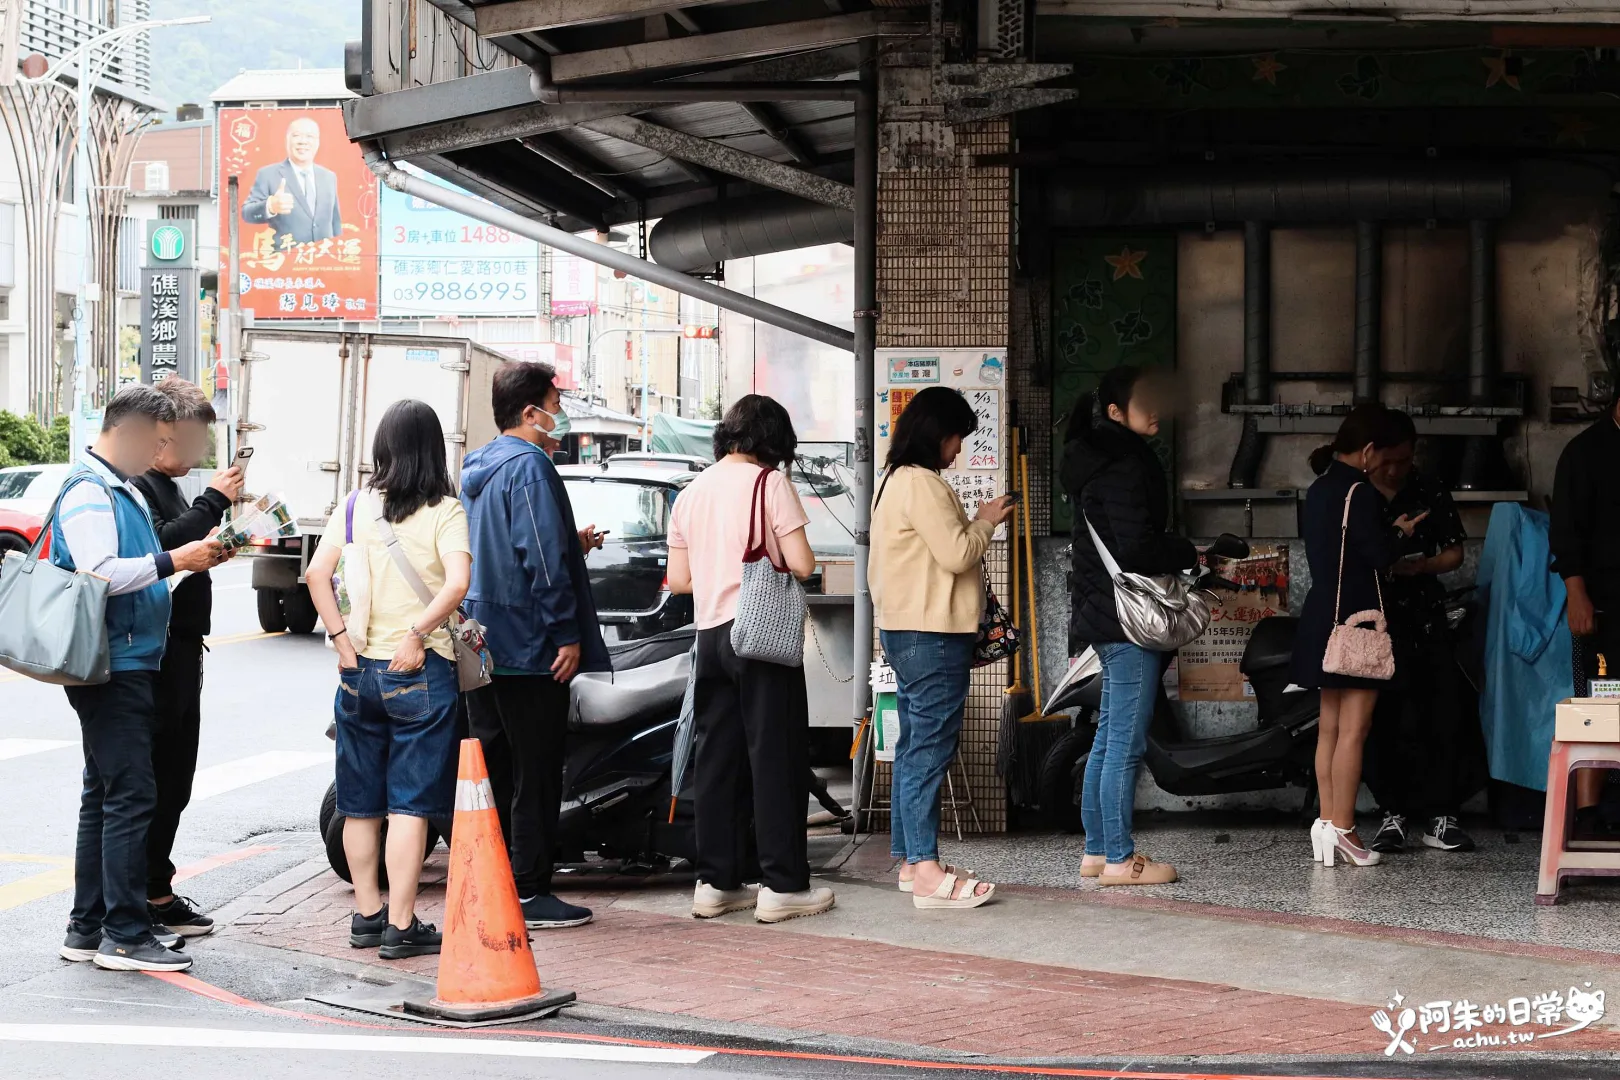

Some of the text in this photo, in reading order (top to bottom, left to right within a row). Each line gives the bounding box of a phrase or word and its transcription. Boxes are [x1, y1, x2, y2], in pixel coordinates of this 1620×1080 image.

[235, 123, 252, 138] 福
[394, 225, 456, 244] 3房+車位
[246, 227, 362, 271] 馬年行大運
[393, 259, 528, 276] 礁溪鄉仁愛路90巷
[974, 391, 991, 404] 4/13
[973, 440, 992, 453] 4/20
[969, 454, 997, 466] 公休
[1203, 626, 1252, 637] 115年5月2
[878, 668, 896, 684] 垃
